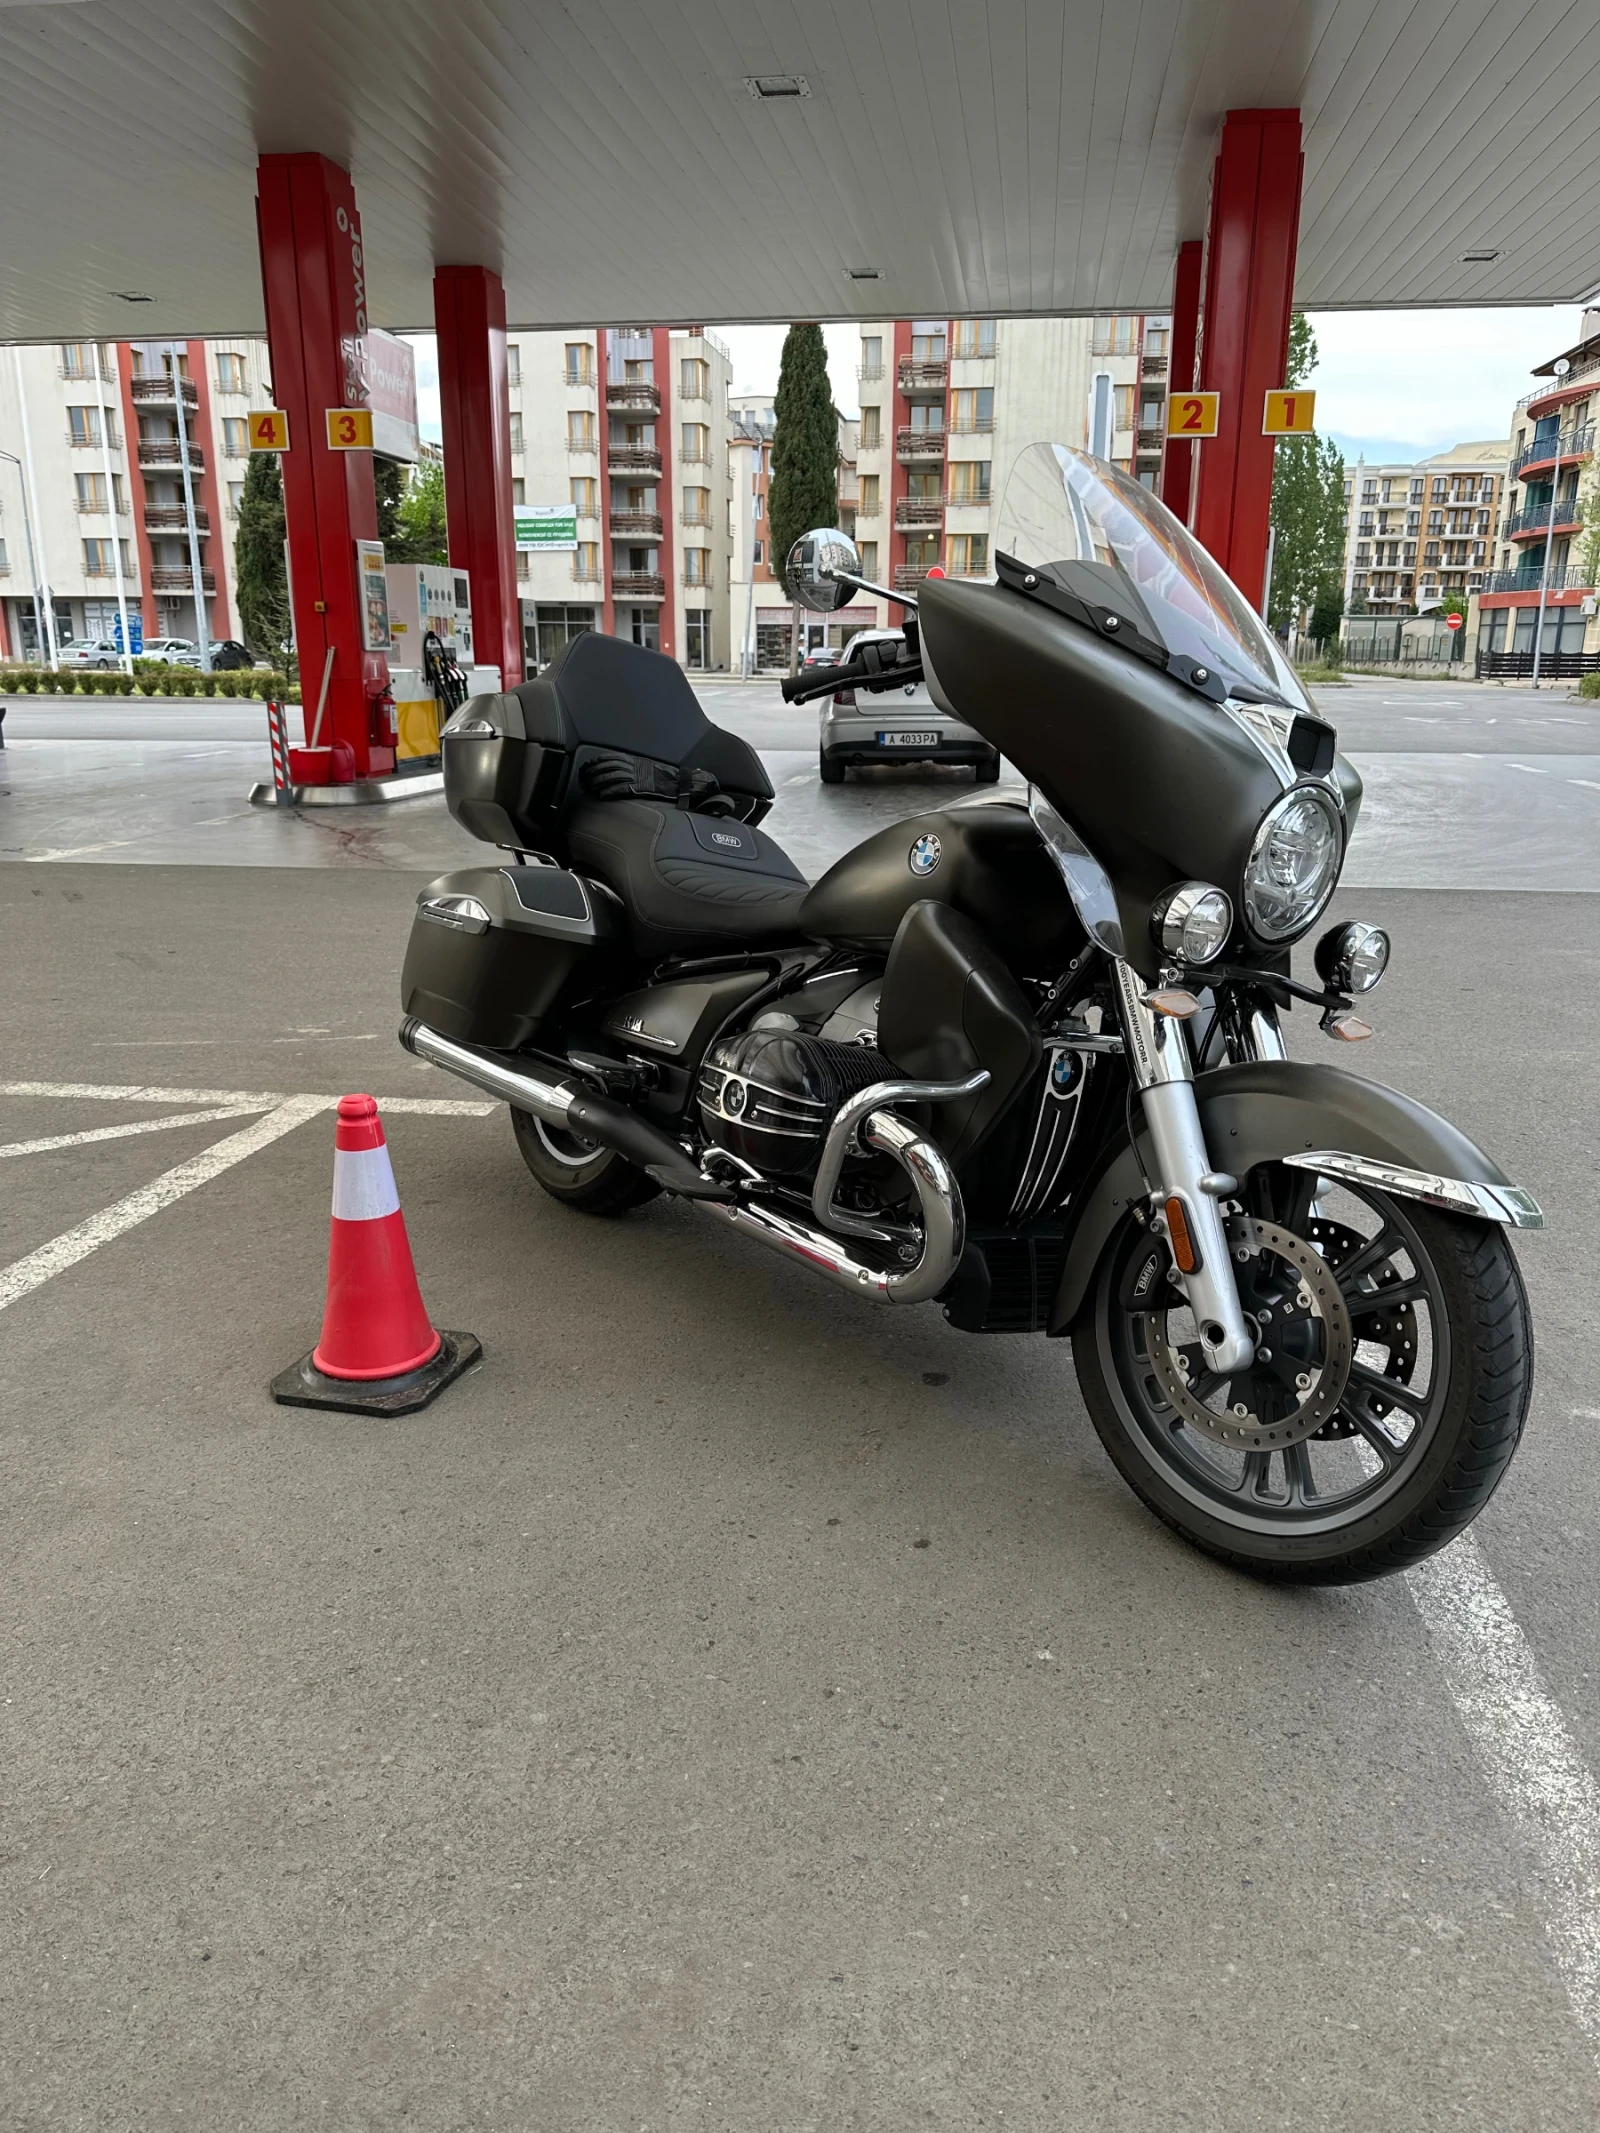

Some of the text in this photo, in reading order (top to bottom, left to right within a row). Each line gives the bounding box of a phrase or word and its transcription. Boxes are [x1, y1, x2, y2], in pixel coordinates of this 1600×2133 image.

[1181, 399, 1203, 429] 2
[1283, 397, 1296, 427] 1
[257, 417, 276, 443] 4
[338, 415, 357, 443] 3
[889, 734, 896, 744] A
[1139, 1262, 1155, 1289] BMW
